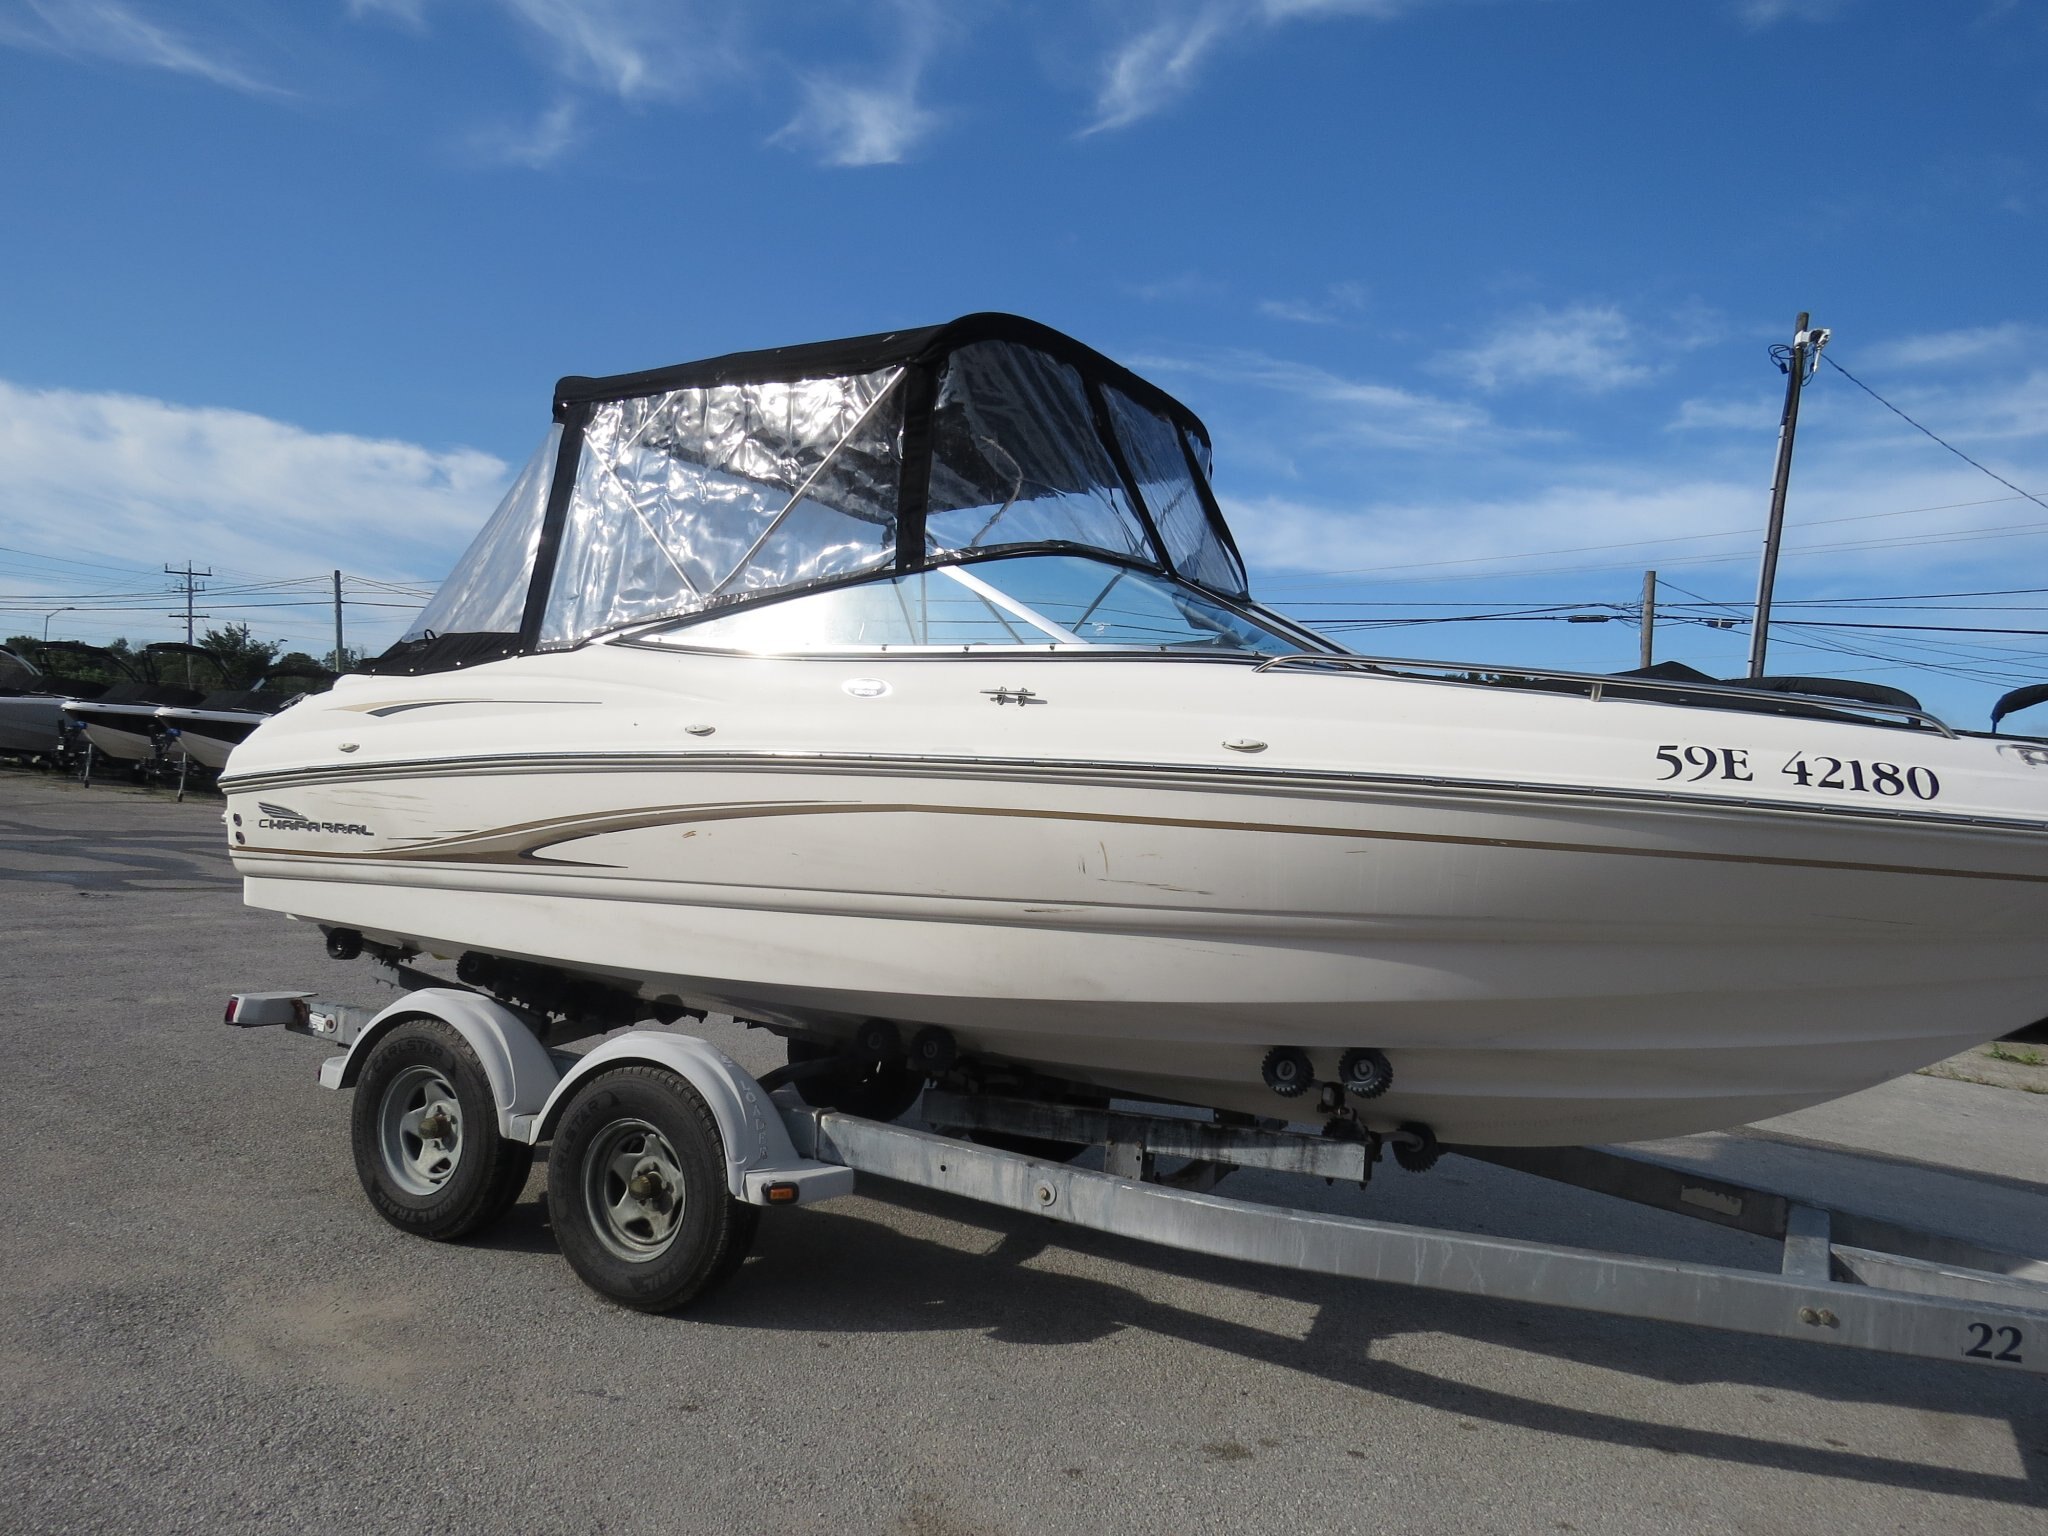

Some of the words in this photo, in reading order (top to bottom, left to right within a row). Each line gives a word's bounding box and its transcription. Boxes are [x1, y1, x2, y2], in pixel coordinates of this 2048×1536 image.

[1655, 744, 1754, 783] 59E
[1781, 750, 1940, 800] 42180
[258, 818, 375, 837] CHAPARRAL
[1965, 1322, 2024, 1364] 22
